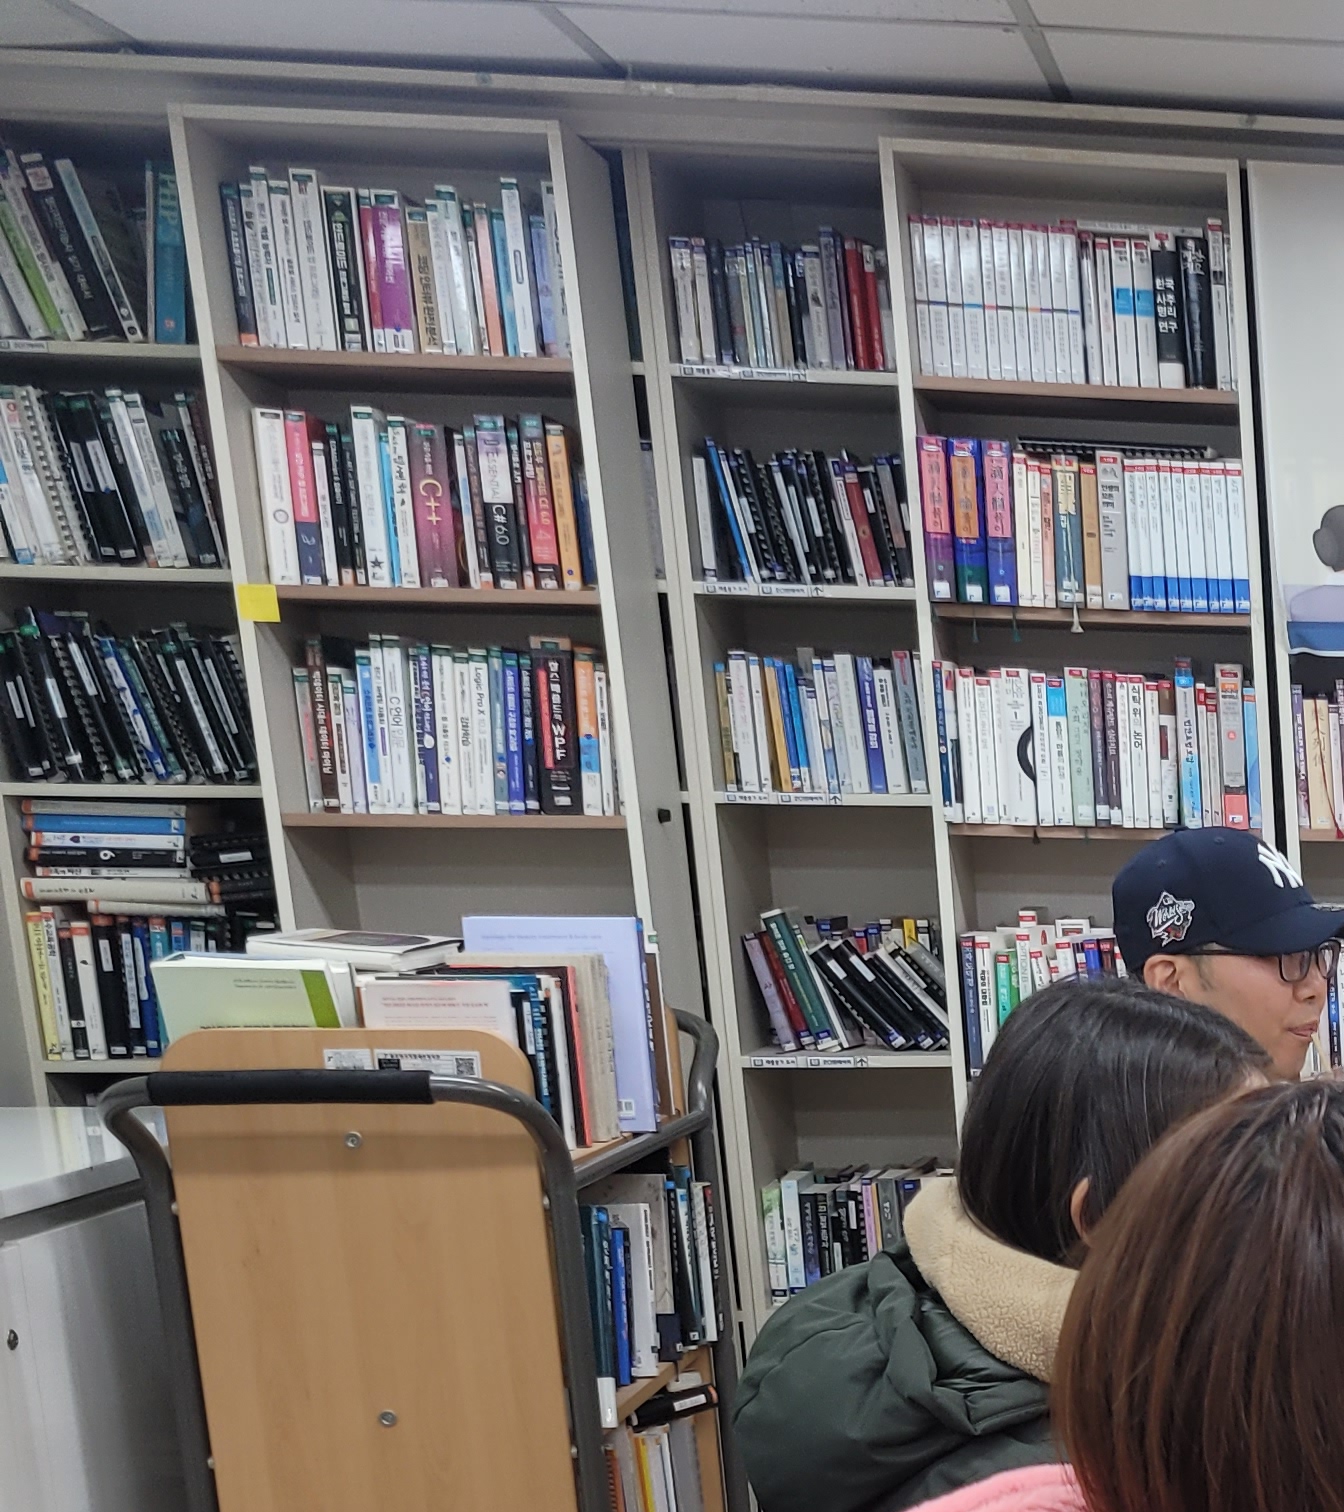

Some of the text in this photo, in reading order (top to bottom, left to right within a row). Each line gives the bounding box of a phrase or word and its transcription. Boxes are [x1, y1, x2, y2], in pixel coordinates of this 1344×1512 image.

[332, 222, 348, 270] 안드로이드
[419, 275, 431, 304] 인터뷰
[1155, 278, 1176, 290] 한국
[1157, 292, 1177, 305] 사주
[1157, 305, 1177, 318] 명리
[1159, 320, 1178, 334] 연구
[419, 480, 442, 525] C++
[491, 505, 508, 524] C#
[540, 511, 550, 526] 6.0
[495, 525, 510, 546] 6.0
[474, 666, 484, 691] Logic
[389, 697, 400, 705] C
[476, 692, 485, 708] Pro
[1131, 685, 1141, 705] 식탁
[389, 706, 403, 727] 언어
[318, 726, 331, 750] 데이터
[551, 721, 567, 761] WPF
[1133, 730, 1143, 750] 논어
[321, 751, 333, 774] 마이닝
